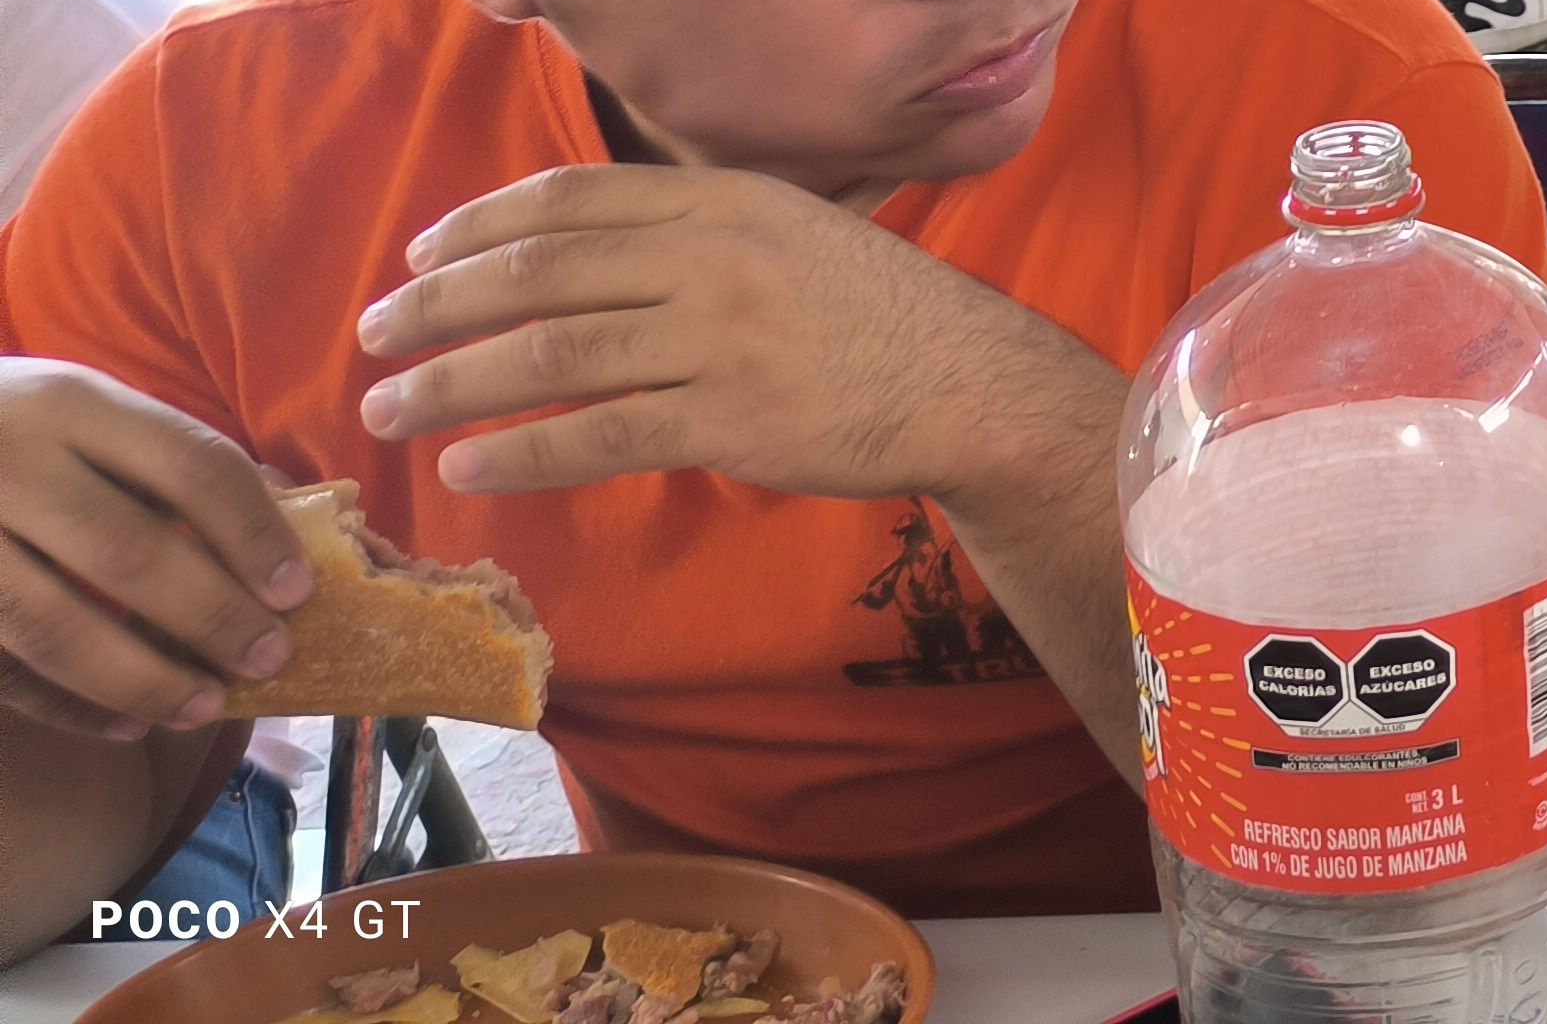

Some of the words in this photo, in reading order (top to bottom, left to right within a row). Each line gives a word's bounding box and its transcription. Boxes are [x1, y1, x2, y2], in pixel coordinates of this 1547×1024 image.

[1263, 665, 1326, 681] EXCESO
[1369, 658, 1436, 679] EXCESO
[1258, 679, 1337, 697] CALORÍAS
[1359, 672, 1447, 695] AZÚCARES
[1431, 788, 1444, 810] 3
[1452, 784, 1464, 805] L
[1243, 818, 1322, 851] REFRESCO
[1326, 827, 1382, 851] SABOR
[1386, 812, 1466, 849] MANZANA
[1230, 842, 1259, 871] CON
[1262, 850, 1287, 875] 1%
[1289, 853, 1311, 877] DE
[1314, 854, 1358, 879] JUGO
[1362, 855, 1384, 878] DE
[1388, 839, 1468, 877] MANZANA
